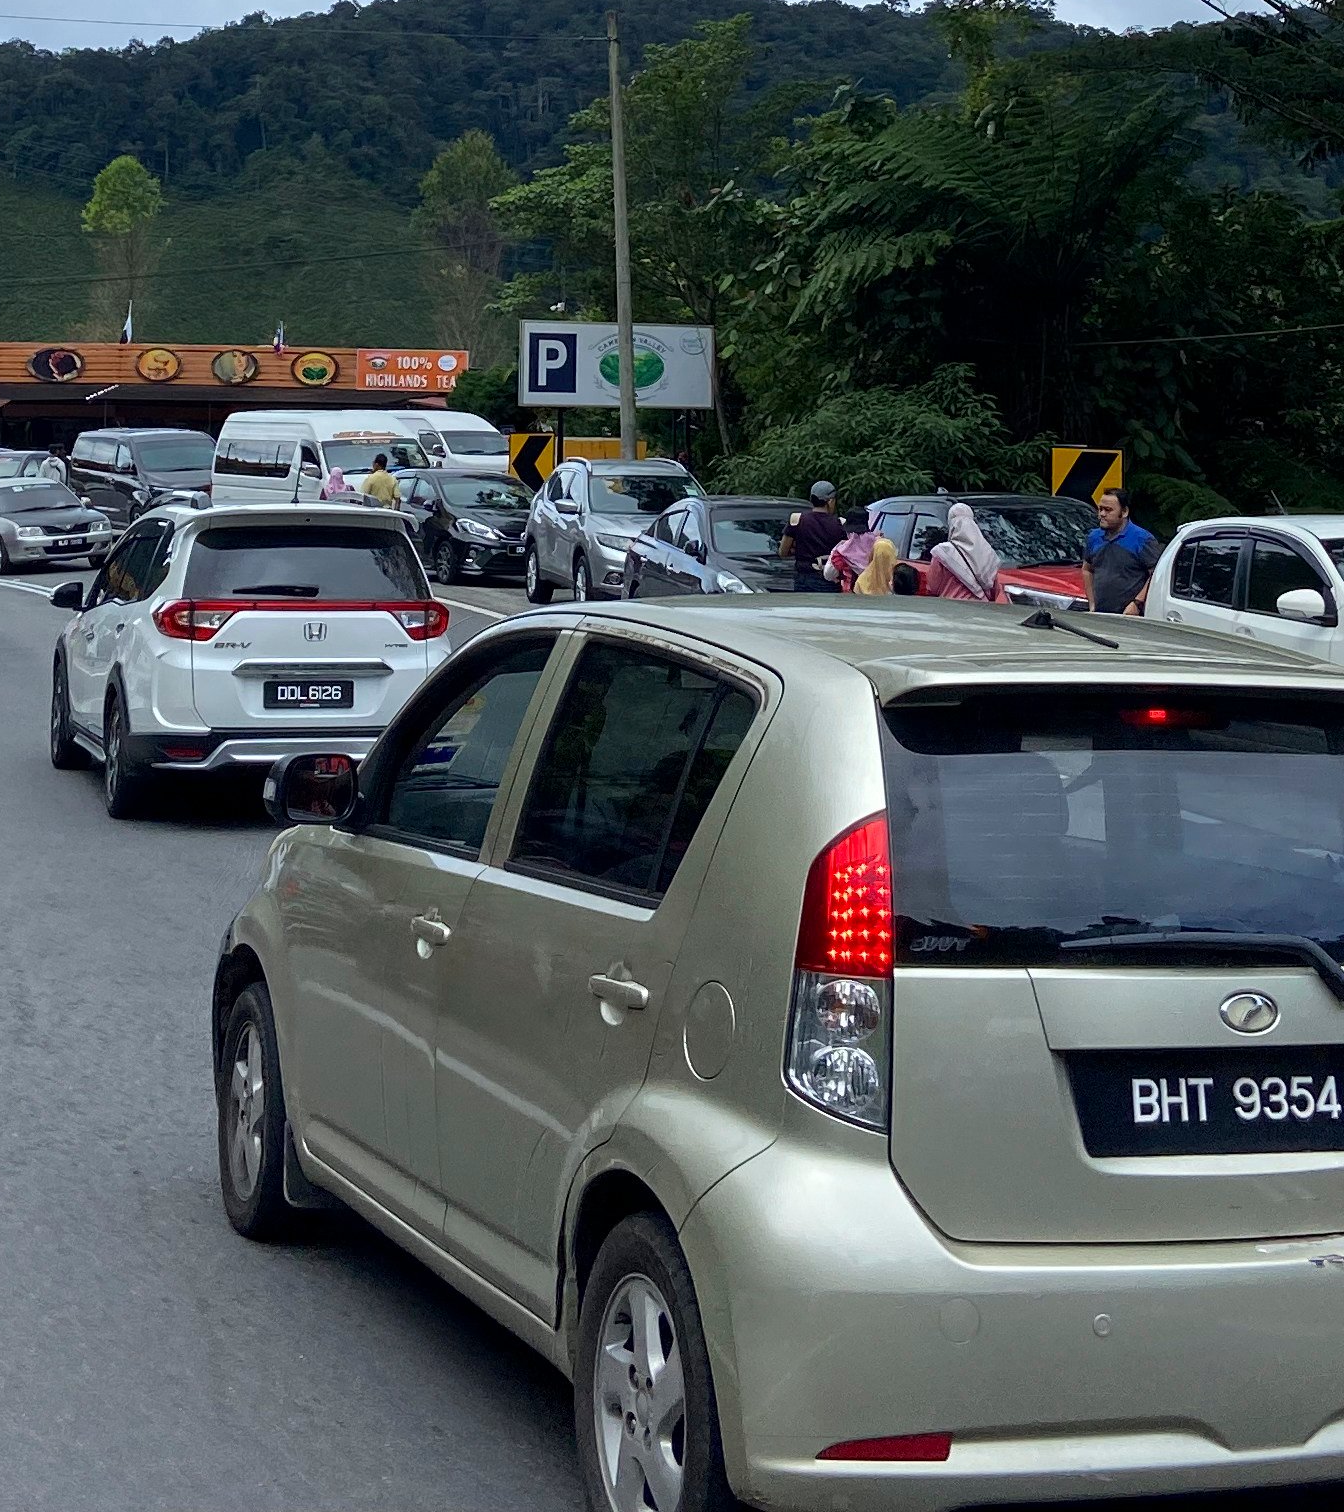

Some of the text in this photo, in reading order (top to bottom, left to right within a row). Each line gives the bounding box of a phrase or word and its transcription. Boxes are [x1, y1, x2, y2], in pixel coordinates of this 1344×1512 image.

[639, 337, 667, 354] VALLEY
[397, 356, 433, 370] 100%
[537, 339, 568, 386] P
[365, 373, 457, 389] HIGHLANDS TEA
[1131, 1075, 1343, 1124] BHT 9354
